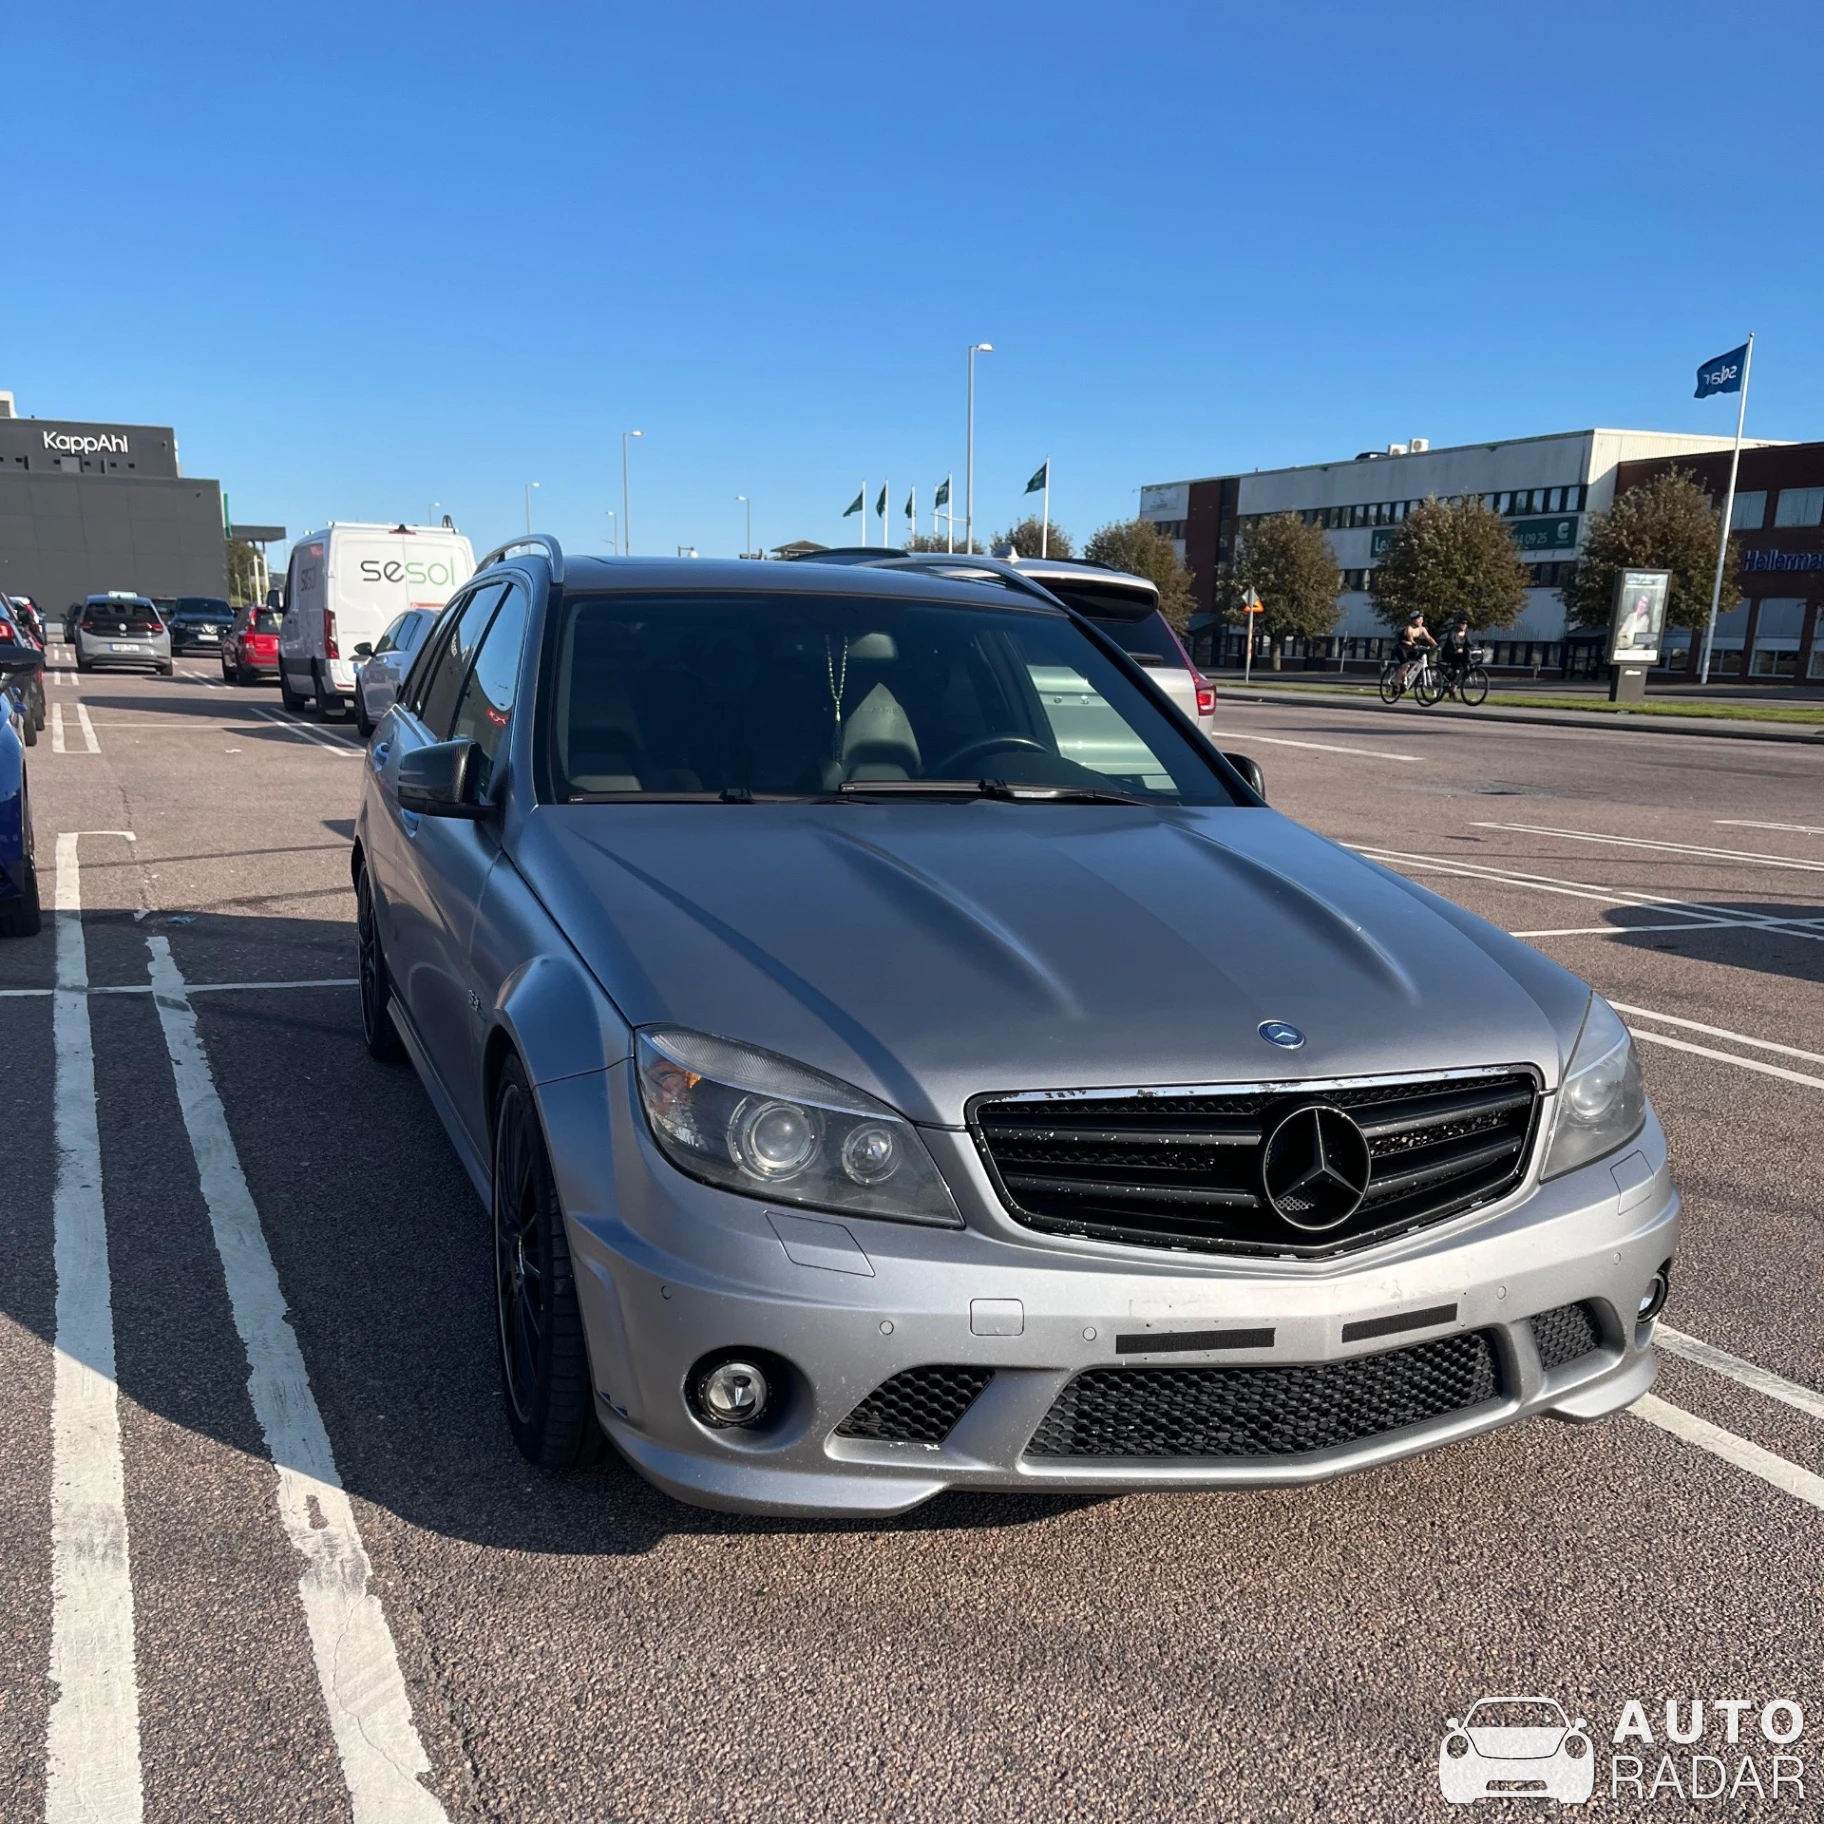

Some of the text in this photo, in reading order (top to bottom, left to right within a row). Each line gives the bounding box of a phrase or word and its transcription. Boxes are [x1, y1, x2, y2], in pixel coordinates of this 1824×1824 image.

[43, 431, 128, 454] KappAhl
[360, 556, 456, 587] sesol
[1744, 549, 1824, 571] Hellerma
